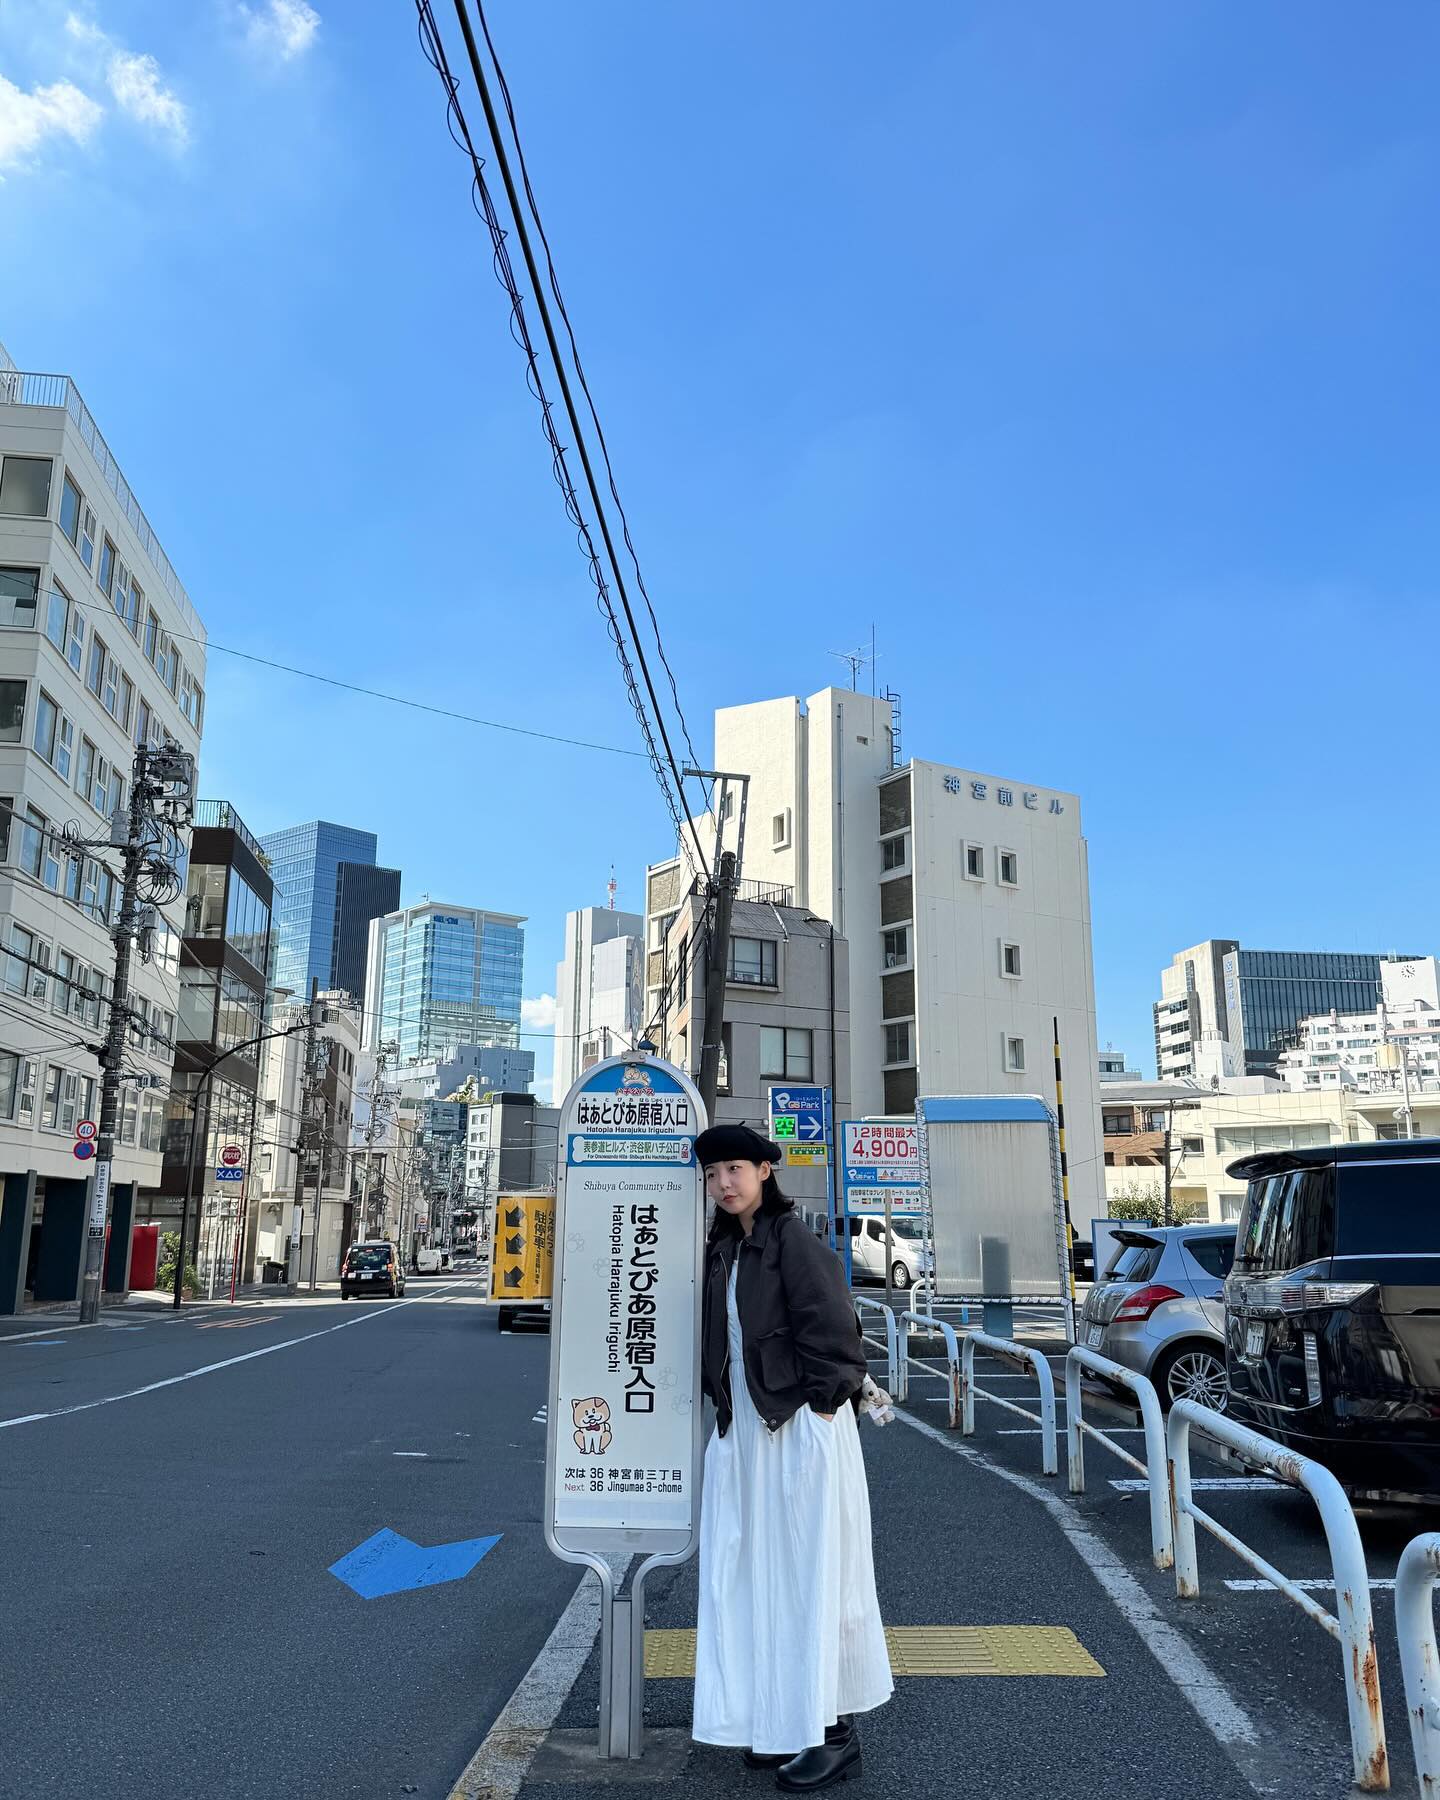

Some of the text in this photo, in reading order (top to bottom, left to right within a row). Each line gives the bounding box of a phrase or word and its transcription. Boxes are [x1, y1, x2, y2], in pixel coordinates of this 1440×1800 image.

[943, 773, 1065, 816] 神宮前ビル
[801, 1101, 820, 1109] Park
[578, 1102, 688, 1126] はぁとぴあ原宿入口
[81, 1125, 93, 1135] 40
[586, 1126, 613, 1134] Hatopia
[615, 1126, 647, 1134] Harajuku
[774, 1116, 795, 1138] 空
[852, 1127, 917, 1138] 12時間最大
[852, 1139, 918, 1158] 4,900円
[583, 1180, 682, 1192] Shibuya Community Bus
[606, 1205, 624, 1373] Hatopia Harajuku Iriguchi
[624, 1204, 659, 1413] はぁとぴあ原宿入口
[564, 1467, 682, 1481] 次は 36 神宮前三丁目
[564, 1480, 682, 1493] Next 36 Jingumae 3-chome
